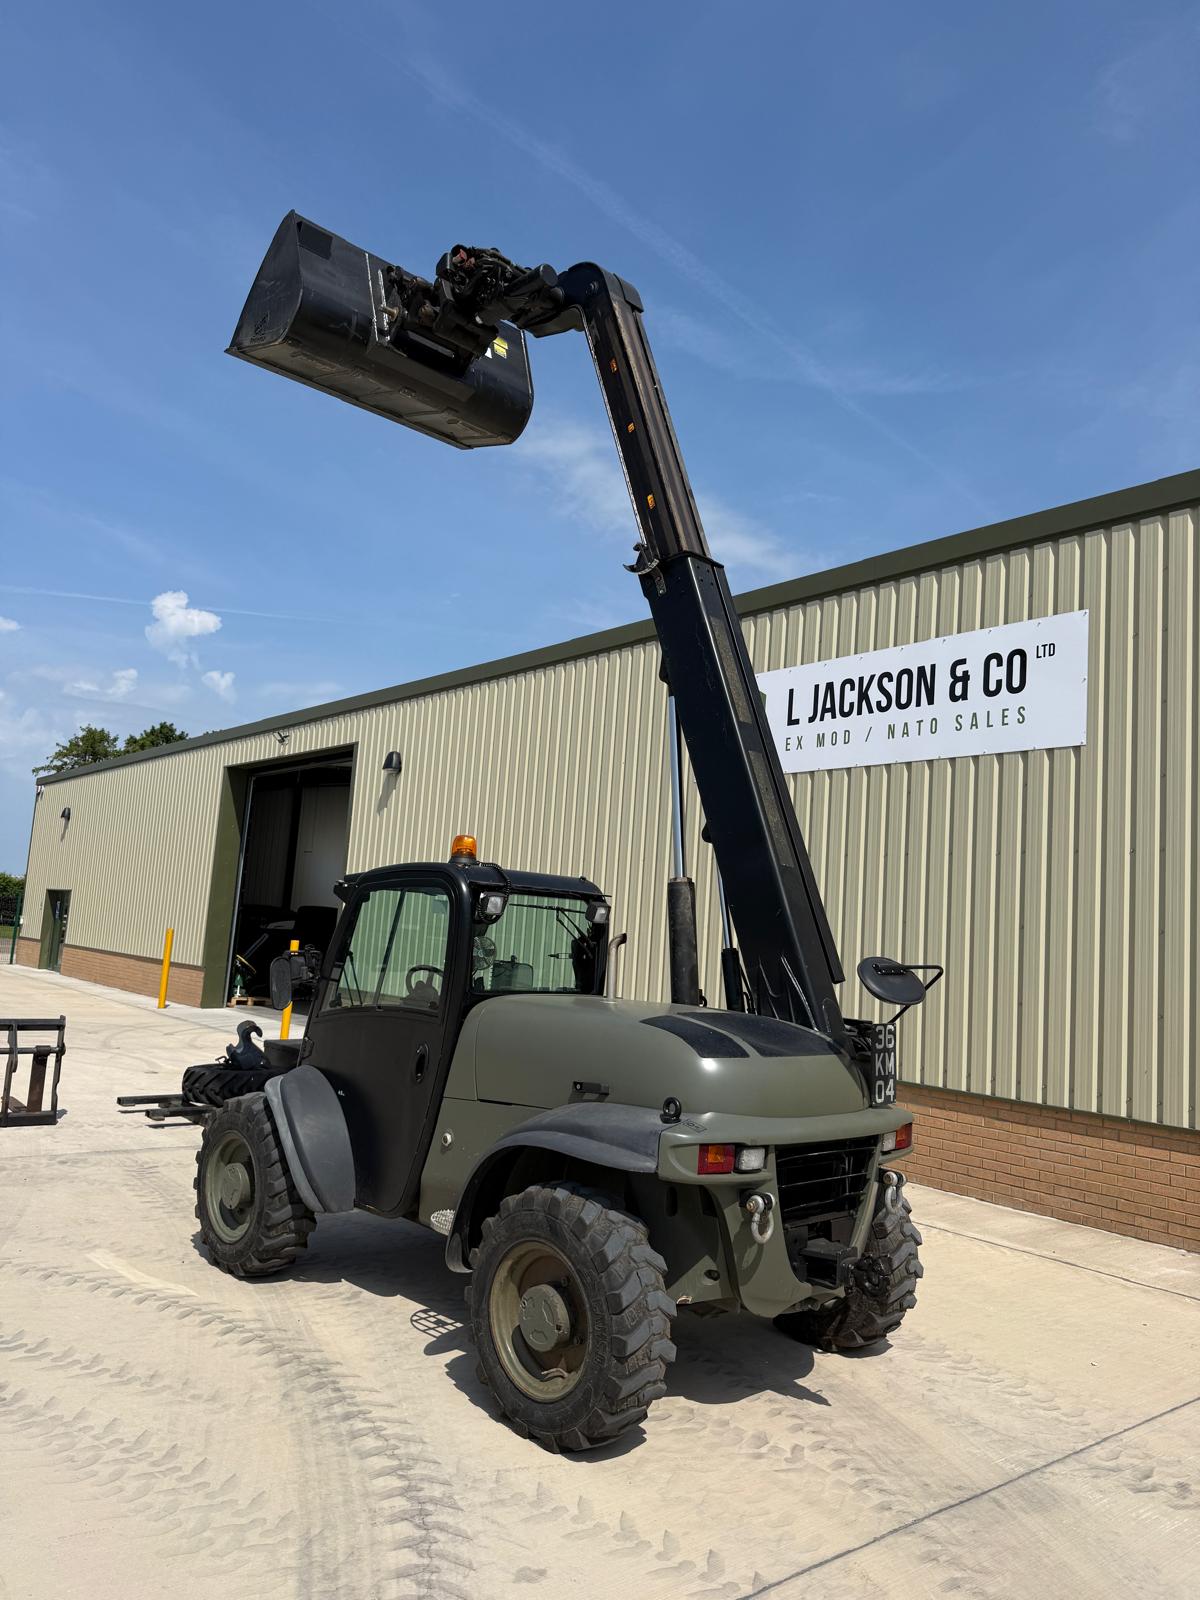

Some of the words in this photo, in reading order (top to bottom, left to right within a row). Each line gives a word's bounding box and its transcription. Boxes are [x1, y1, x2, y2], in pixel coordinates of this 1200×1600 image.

[787, 688, 800, 726] L
[808, 664, 936, 724] JACKSON
[949, 658, 970, 703] &
[982, 648, 1027, 697] CO
[1035, 642, 1056, 659] LTD
[785, 735, 803, 751] EX
[816, 729, 851, 748] MOD
[865, 727, 872, 742] /
[887, 718, 938, 739] NATO
[955, 706, 1026, 732] SALES
[875, 1025, 895, 1049] 36
[875, 1051, 895, 1077] KM
[875, 1078, 895, 1104] 04
